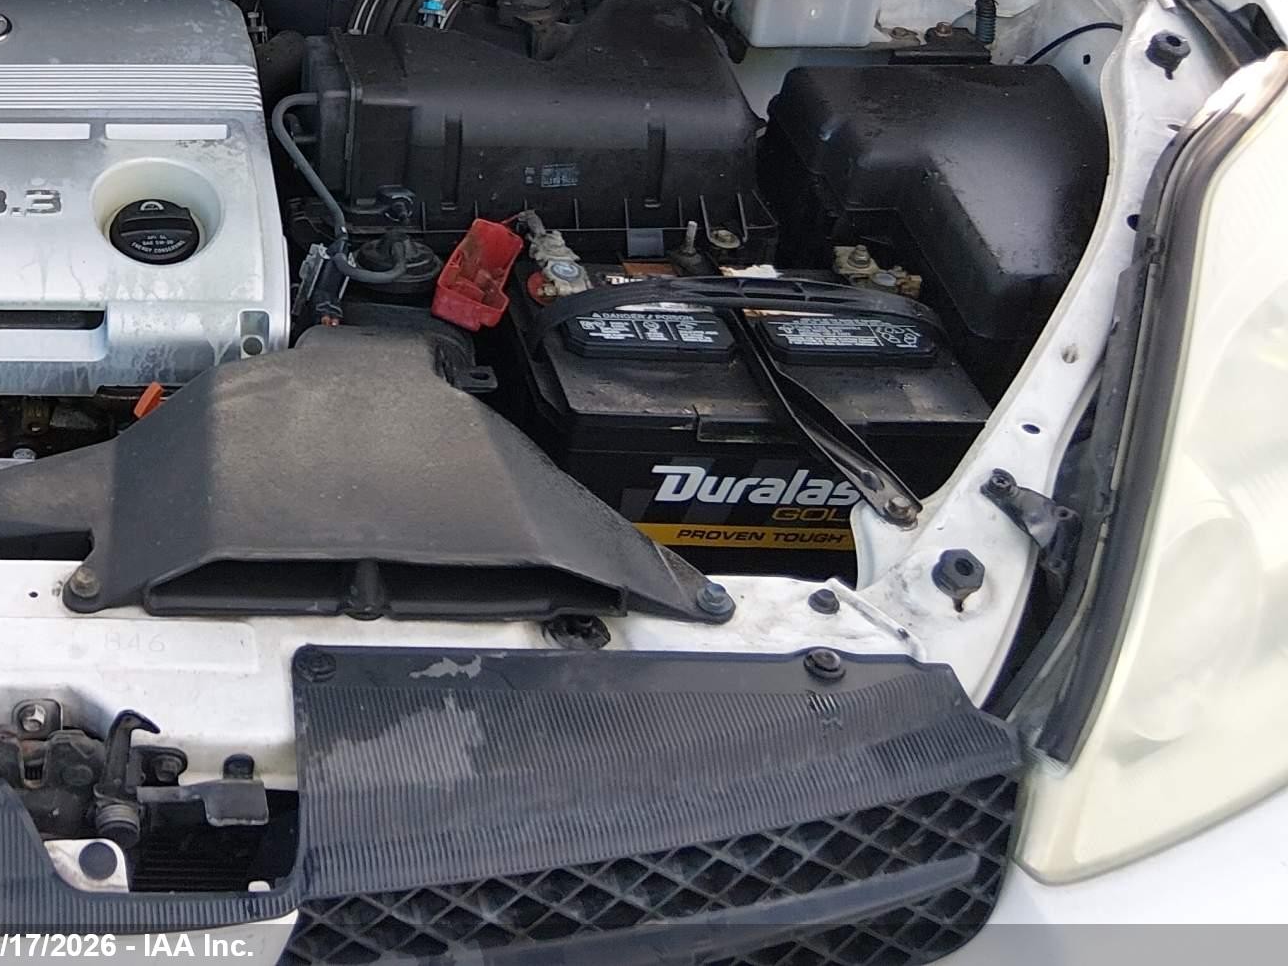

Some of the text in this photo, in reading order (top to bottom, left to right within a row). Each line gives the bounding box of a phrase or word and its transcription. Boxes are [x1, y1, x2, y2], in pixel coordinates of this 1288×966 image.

[652, 465, 862, 506] Duralas
[772, 507, 847, 522] GOL
[676, 528, 846, 544] PROVEN TOUGH
